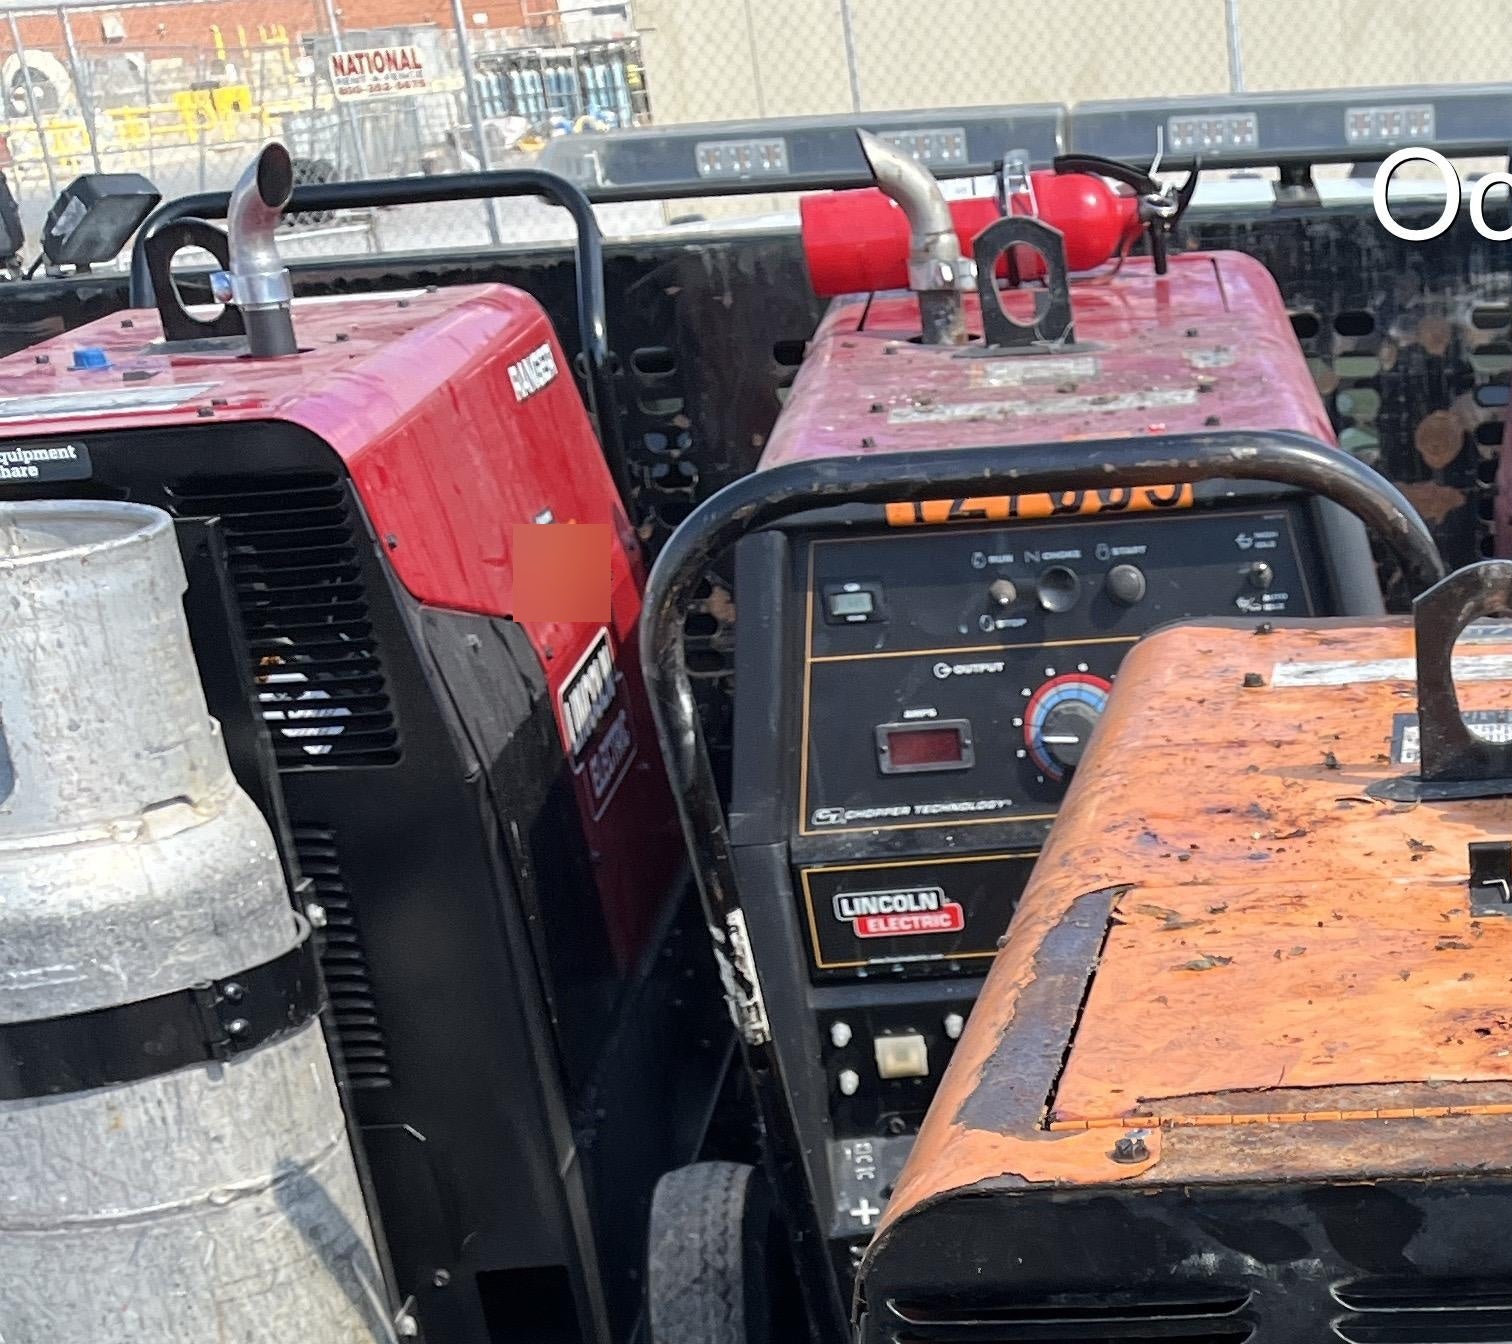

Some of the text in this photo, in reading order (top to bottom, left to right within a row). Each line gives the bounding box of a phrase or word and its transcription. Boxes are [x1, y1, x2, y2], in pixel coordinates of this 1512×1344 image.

[332, 48, 423, 77] NATIONAL
[952, 661, 1005, 675] OUTPUT
[844, 806, 911, 820] CHOPPER
[840, 892, 939, 917] LINCOLN
[866, 913, 953, 933] ELECTRIC
